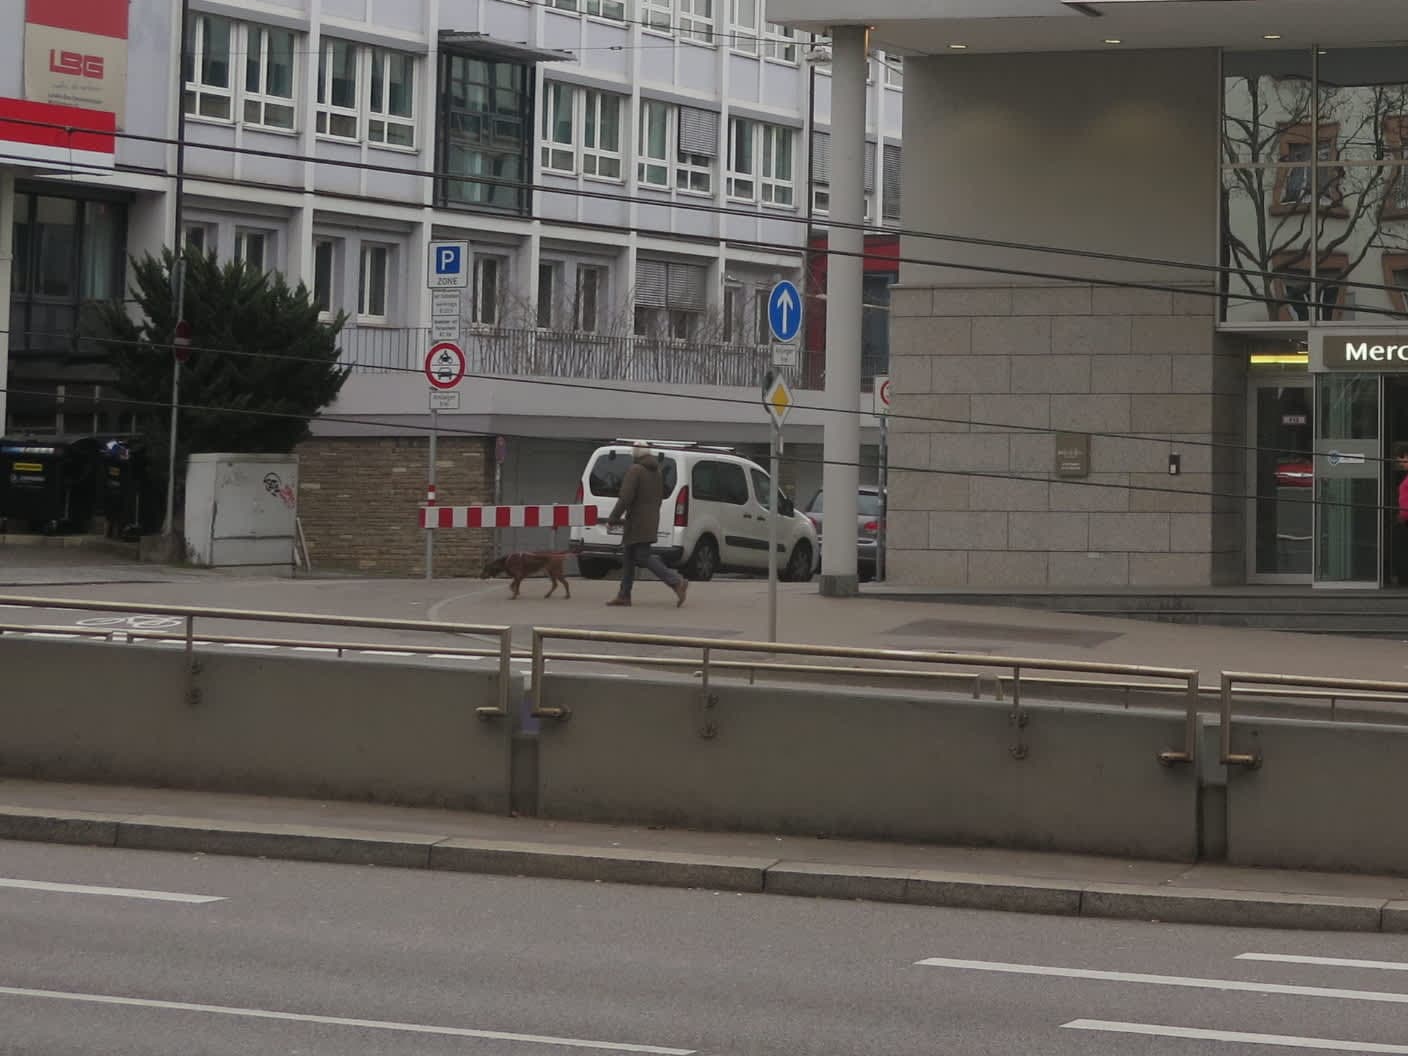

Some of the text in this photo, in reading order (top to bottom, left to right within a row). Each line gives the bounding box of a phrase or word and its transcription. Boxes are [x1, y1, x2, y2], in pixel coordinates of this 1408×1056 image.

[49, 49, 104, 80] LBG
[441, 250, 455, 271] P
[438, 277, 457, 286] ZONE
